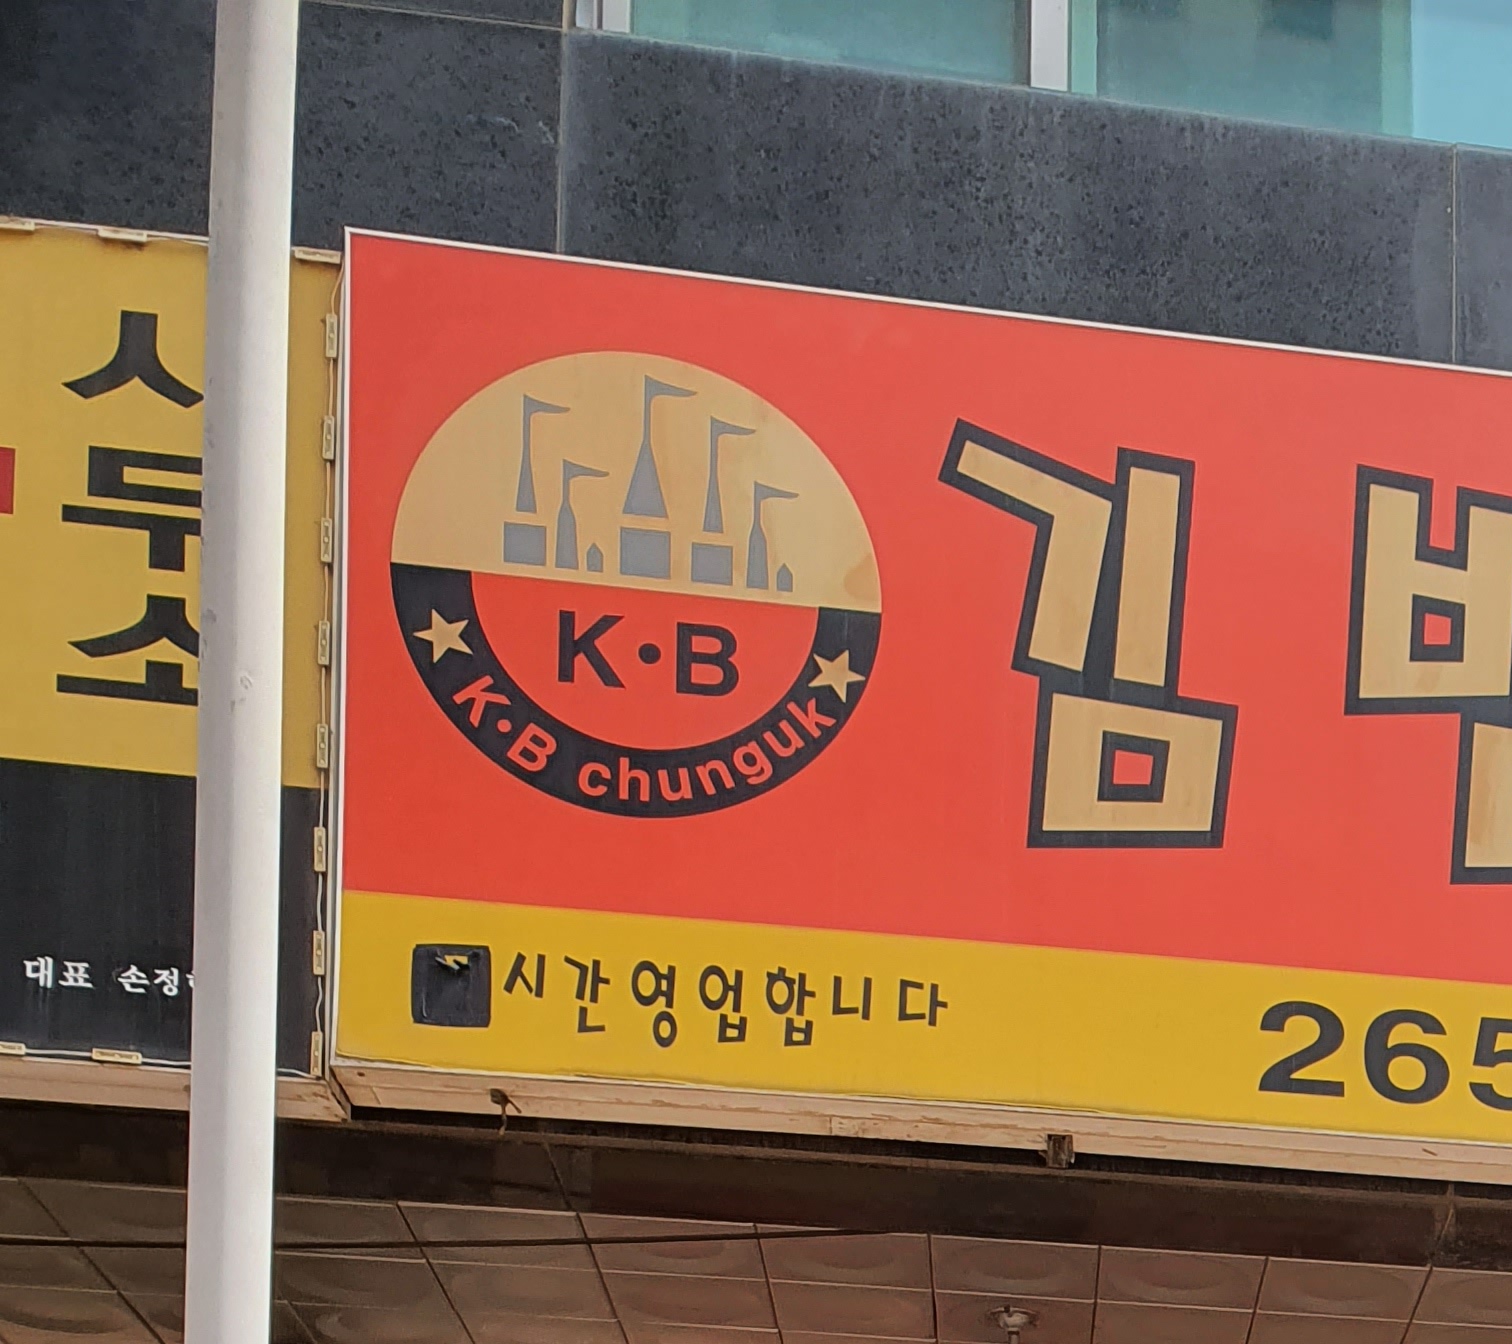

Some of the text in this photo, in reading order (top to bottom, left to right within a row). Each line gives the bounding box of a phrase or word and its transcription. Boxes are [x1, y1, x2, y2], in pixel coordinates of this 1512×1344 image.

[577, 694, 838, 802] chunguk
[23, 955, 96, 989] 대표
[502, 950, 949, 1048] 시간영업합니다
